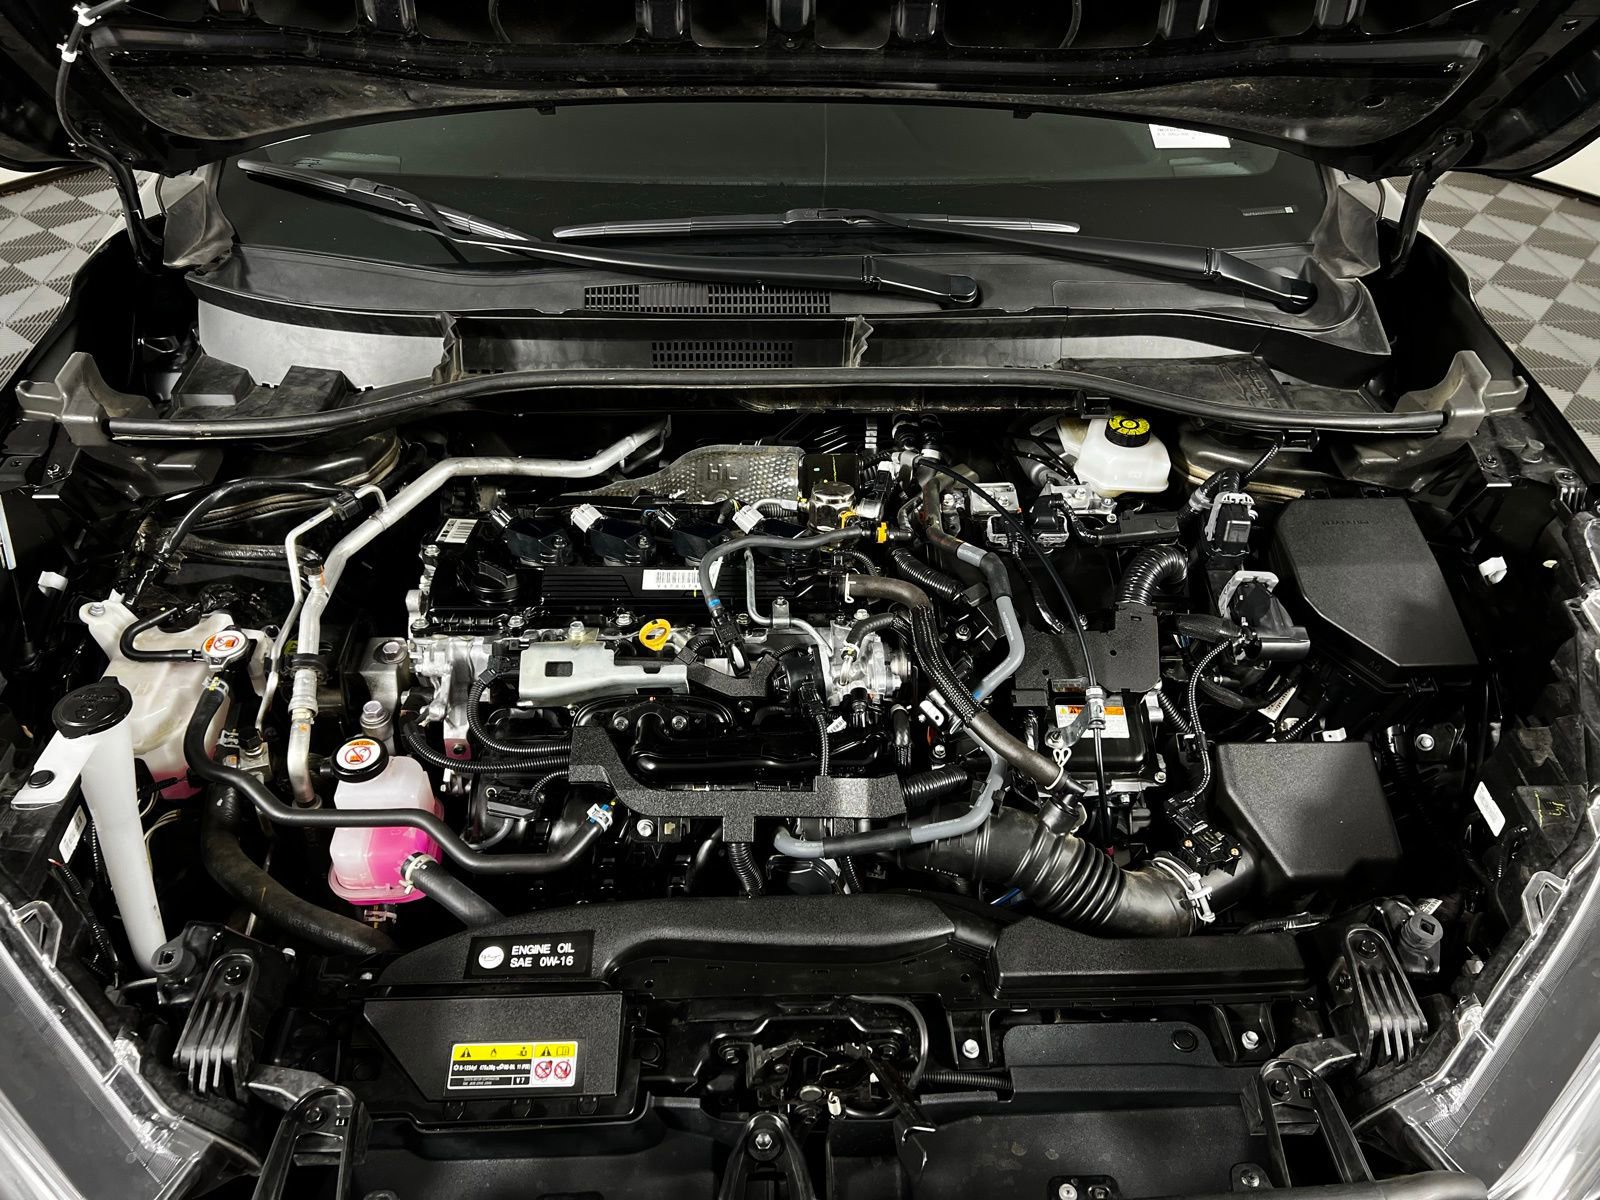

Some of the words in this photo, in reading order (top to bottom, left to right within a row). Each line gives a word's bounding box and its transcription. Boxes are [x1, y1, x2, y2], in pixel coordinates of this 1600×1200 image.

[511, 943, 551, 955] ENGINE
[556, 942, 575, 954] OIL
[509, 957, 533, 968] SAE
[539, 956, 574, 967] 0W-16
